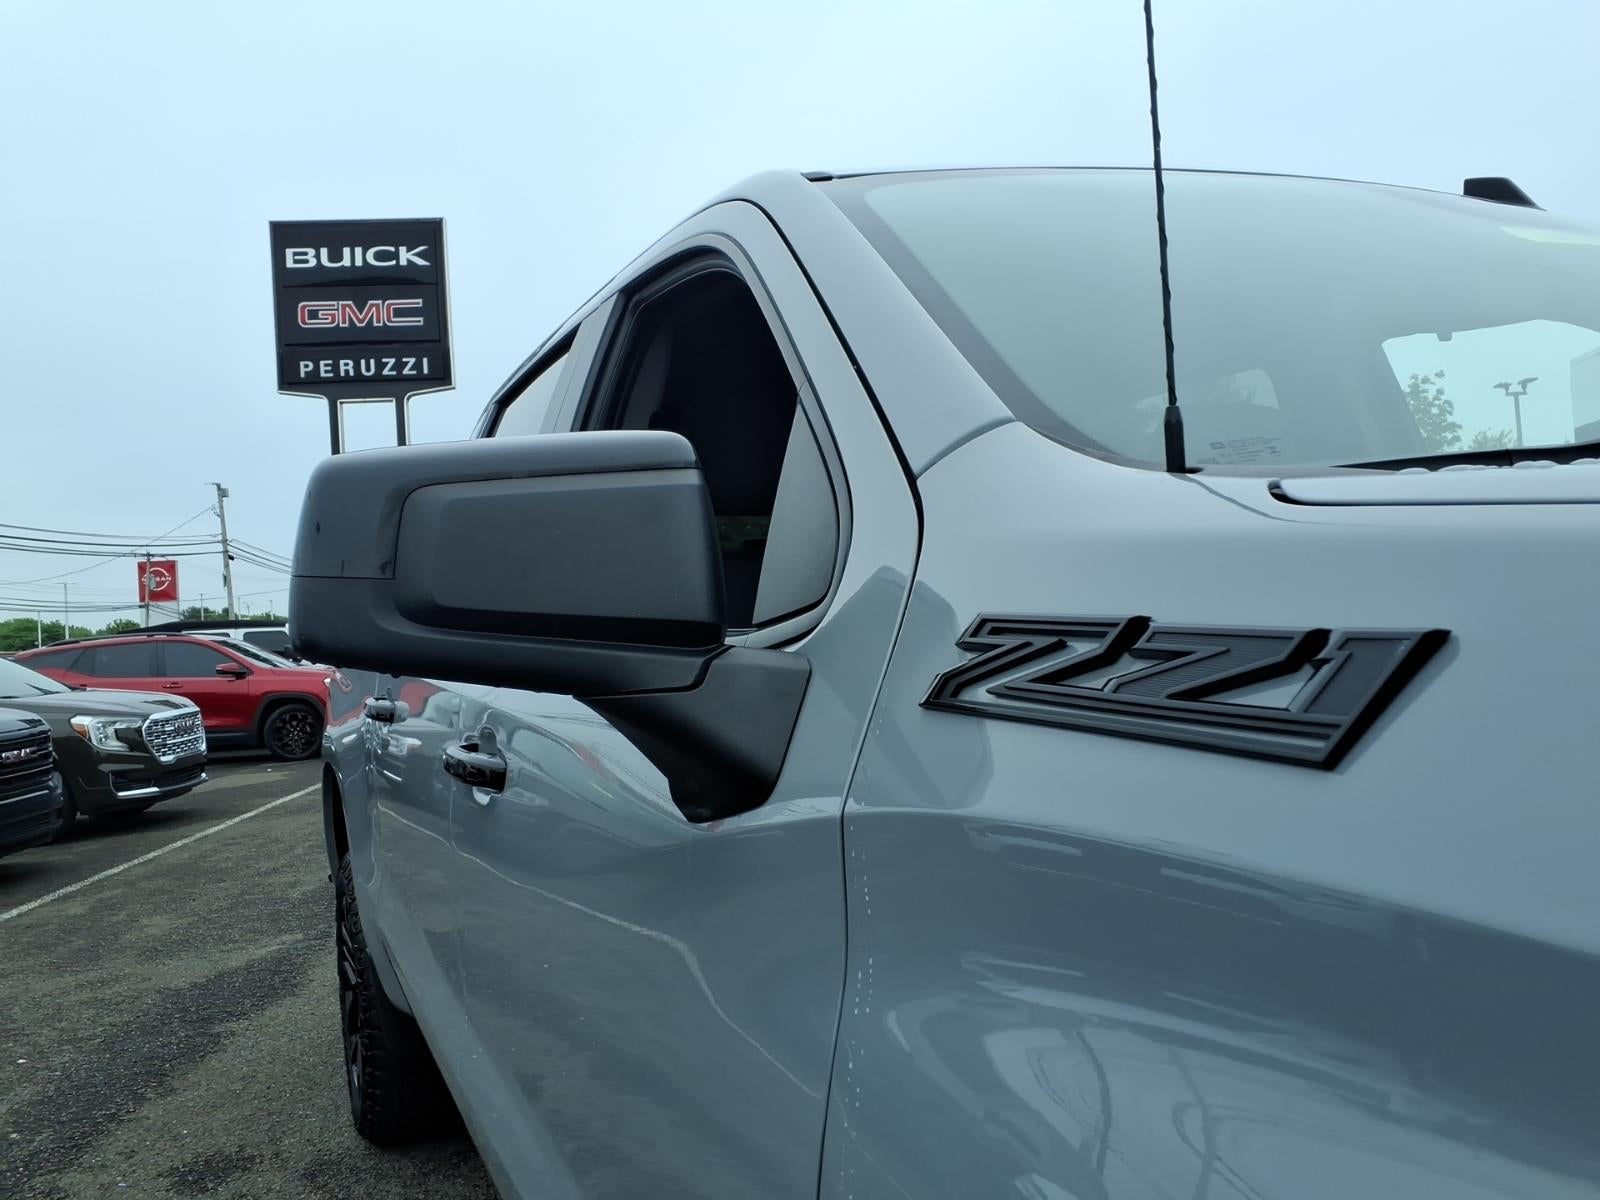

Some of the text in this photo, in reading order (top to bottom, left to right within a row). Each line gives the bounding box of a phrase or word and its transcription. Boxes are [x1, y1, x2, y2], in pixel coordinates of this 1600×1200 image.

[285, 246, 431, 268] BUICK
[298, 299, 424, 328] GMC
[300, 357, 430, 378] PERUZZI
